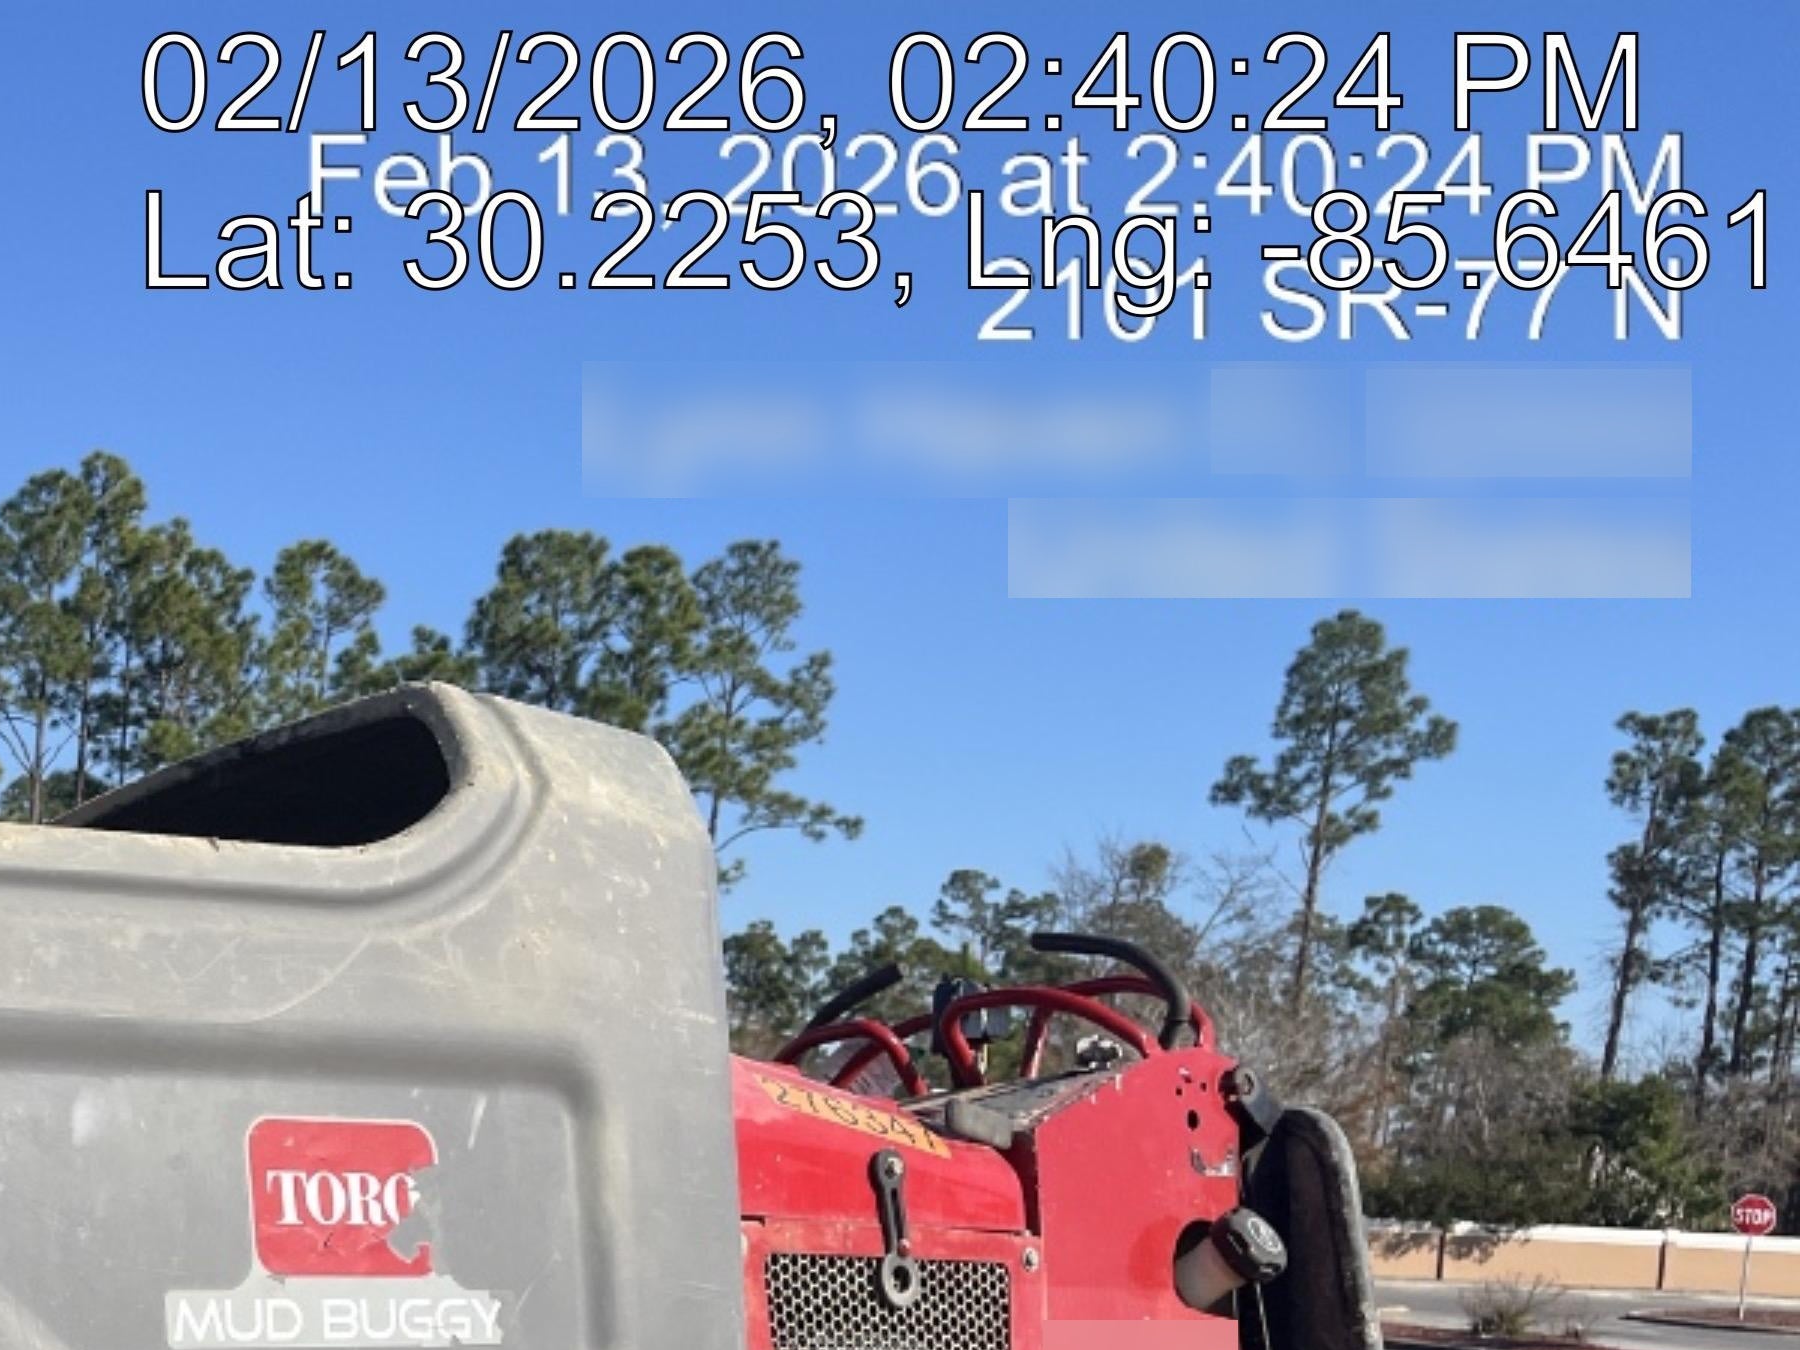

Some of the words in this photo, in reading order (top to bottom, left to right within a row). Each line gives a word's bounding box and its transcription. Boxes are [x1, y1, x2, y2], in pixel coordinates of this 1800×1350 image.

[1735, 1207, 1771, 1225] STOP
[173, 1297, 305, 1343] MUD
[322, 1298, 503, 1341] BUGGY
